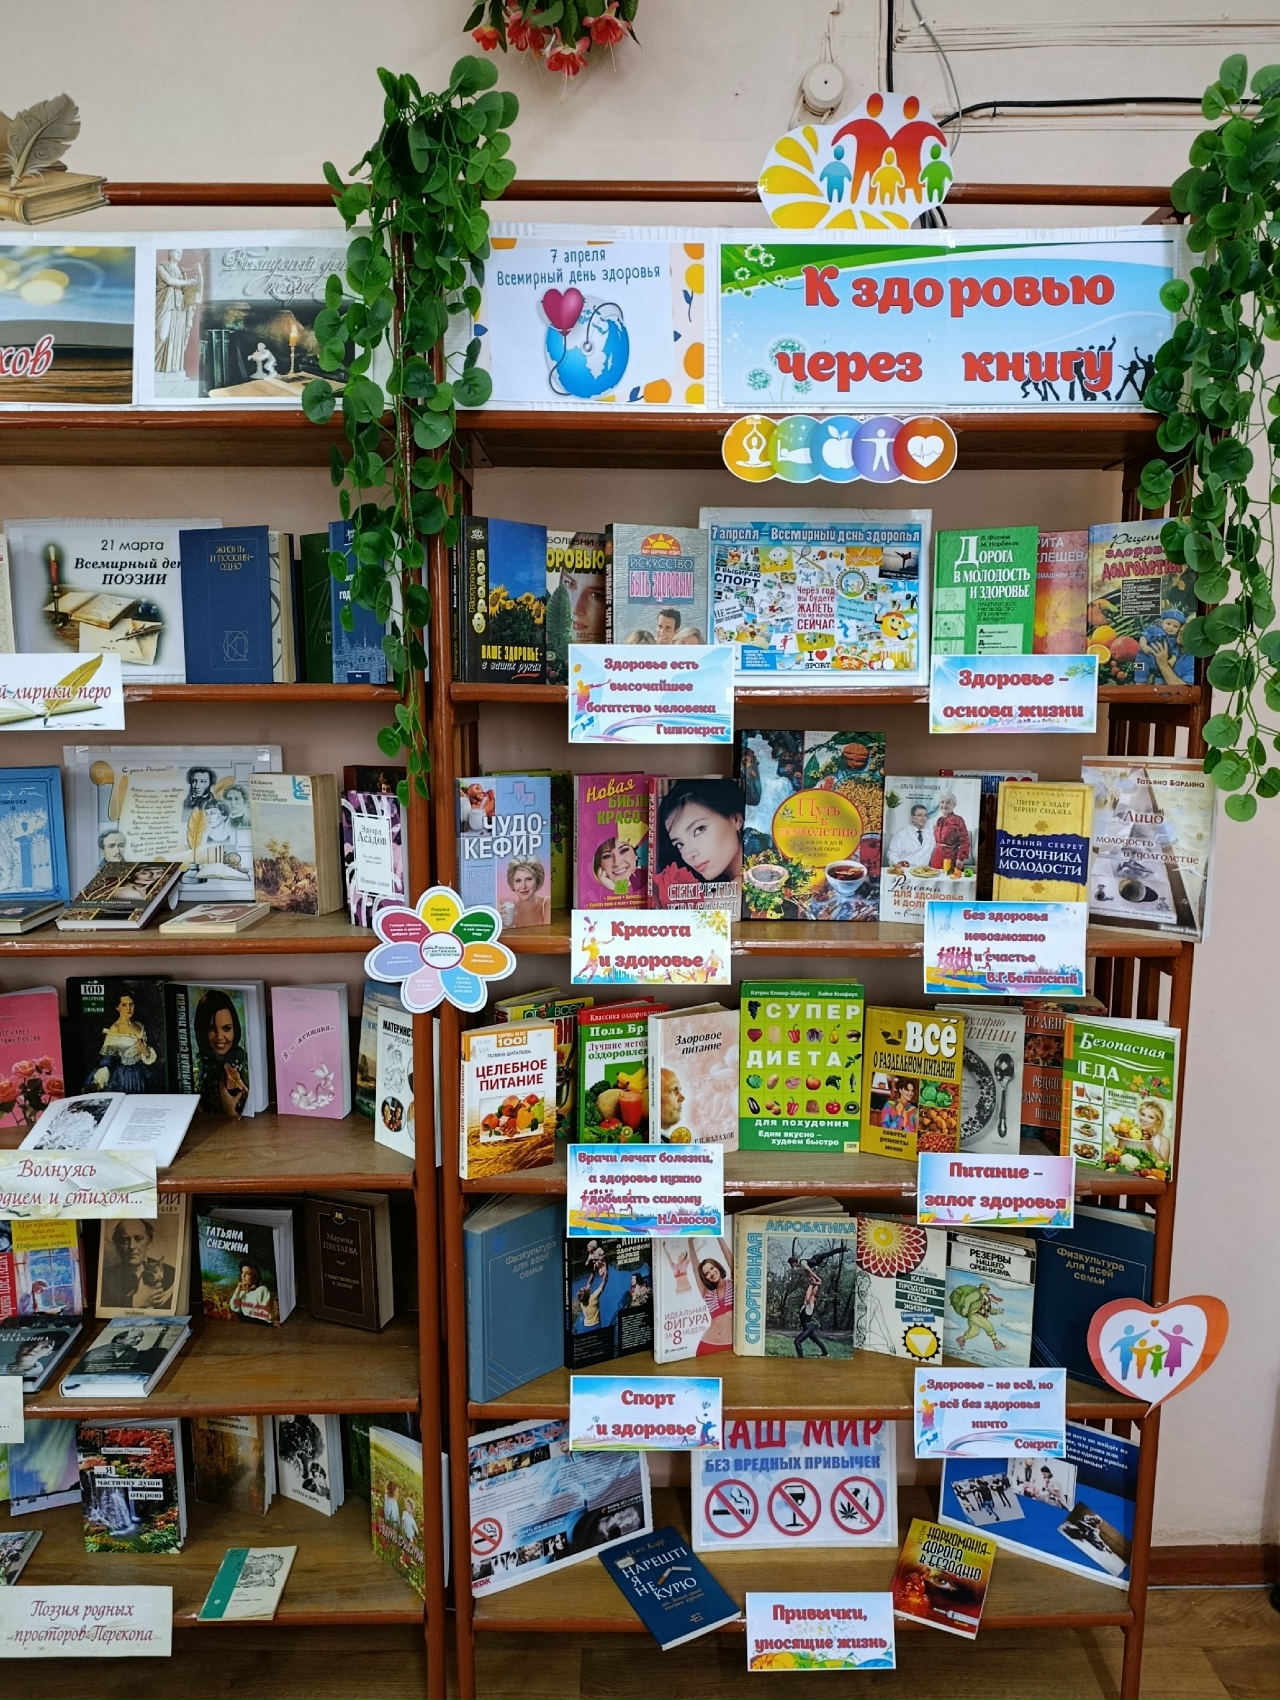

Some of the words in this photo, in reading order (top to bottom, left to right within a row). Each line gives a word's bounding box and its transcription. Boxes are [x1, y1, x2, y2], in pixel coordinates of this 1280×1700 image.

[551, 249, 557, 263] 7
[564, 250, 605, 267] апреля
[497, 269, 563, 289] Всемирный
[569, 270, 596, 284] день
[603, 266, 660, 285] здоровья
[803, 266, 839, 308] К
[853, 266, 1115, 318] здоровью
[774, 351, 922, 393] через
[963, 350, 1114, 393] книгу
[712, 527, 718, 538] 7
[720, 529, 758, 541] апреля
[771, 527, 835, 541] Всемирный
[837, 531, 864, 542] день
[867, 532, 919, 542] здоровья
[101, 540, 114, 550] 21
[119, 540, 163, 552] марта
[216, 546, 245, 554] ЖИЗНЬ
[74, 558, 157, 571] Всемирный
[220, 563, 242, 571] ОДНО
[630, 558, 693, 570] ИСКУССТВО
[102, 574, 167, 585] ПОЭЗИИ
[715, 573, 760, 588] СПОРТ
[963, 568, 1030, 584] МОЛОДОСТЬ
[630, 572, 650, 598] БЫТЬ
[652, 571, 693, 598] ЗДОРОВЫМ
[797, 587, 819, 596] Через
[979, 585, 1030, 599] ЗДОРОВЬЕ
[482, 645, 502, 659] ВАШЕ
[604, 659, 668, 672] Здоровье
[671, 660, 699, 670] есть
[610, 680, 693, 691] высочайшее
[959, 670, 1054, 689] Здоровье
[12, 685, 71, 701] лирики
[76, 686, 111, 703] перо
[586, 702, 651, 713] богатство
[654, 703, 715, 713] человека
[943, 705, 1013, 717] основа
[1018, 705, 1083, 717] жизни
[656, 723, 726, 737] Гиппократ
[1136, 778, 1167, 786] Татьяна
[586, 779, 635, 803] Новая
[797, 799, 841, 818] Путь
[483, 814, 547, 837] ЧУДО-
[1124, 812, 1163, 825] Лицо
[361, 825, 382, 834] Эдуард
[358, 834, 387, 845] Асадов
[1000, 838, 1042, 846] ДРЕВНИЙ
[1048, 842, 1083, 850] СЕКРЕТ
[464, 835, 542, 859] КЕФИР
[999, 848, 1081, 863] ИСТОЧНИКА
[1136, 851, 1199, 864] долголетие
[999, 861, 1082, 876] МОЛОДОСТИ
[668, 882, 737, 900] СЕКРЕТЫ
[894, 891, 912, 899] ДЛЯ
[963, 910, 985, 920] Без
[988, 911, 1048, 923] здоровья
[611, 922, 691, 940] Красота
[964, 933, 1046, 942] невозможно
[599, 956, 610, 967] и
[615, 956, 704, 970] здоровье
[986, 953, 1035, 963] счастье
[986, 972, 1078, 984] В.Г.Белинский
[81, 985, 104, 994] 100
[590, 1013, 620, 1021] Классика
[766, 1004, 860, 1019] СУПЕР
[590, 1026, 624, 1036] Поль
[675, 1031, 722, 1045] Здоровое
[498, 1036, 526, 1047] 100!
[588, 1042, 622, 1052] Лучшие
[1079, 1033, 1166, 1059] Безопасная
[682, 1042, 721, 1056] питание
[747, 1051, 841, 1068] ДИЕТА
[879, 1052, 922, 1074] РАЗДЕЛЬНОМ
[923, 1059, 955, 1079] ПИТАНИИ
[476, 1059, 547, 1078] ЦЕЛЕБНОЕ
[479, 1074, 544, 1091] ПИТАНИЕ
[755, 1119, 778, 1127] для
[883, 1130, 906, 1138] советы
[771, 1138, 803, 1146] худеем
[880, 1137, 909, 1146] рецепты
[578, 1153, 617, 1164] Врачи
[620, 1154, 656, 1163] лечат
[659, 1152, 713, 1165] болезни,
[18, 1159, 96, 1181] Волнуясь
[950, 1162, 1029, 1179] Питание
[600, 1174, 657, 1185] здоровье
[660, 1174, 702, 1185] нужно
[49, 1194, 60, 1204] и
[588, 1194, 649, 1206] добывать
[653, 1195, 702, 1206] самому
[925, 1195, 975, 1207] залог
[980, 1196, 1066, 1212] здоровья
[658, 1214, 716, 1225] Н.Амосов
[766, 1220, 857, 1233] АКРОБАТИКА
[206, 1226, 243, 1240] ТАТЬЯНА
[326, 1233, 354, 1245] Марина
[207, 1239, 248, 1253] СНЕЖИНА
[323, 1242, 357, 1255] ЦВЕТАЕВА
[506, 1241, 556, 1265] Физкультура
[970, 1249, 1012, 1264] РЕЗЕРВЫ
[976, 1258, 1005, 1268] НАШЕГО
[1057, 1248, 1124, 1272] Физкультура
[513, 1262, 528, 1272] для
[1066, 1260, 1085, 1270] для
[1089, 1265, 1114, 1278] всей
[911, 1275, 925, 1283] КАК
[1074, 1272, 1105, 1286] семьи
[745, 1233, 763, 1344] СПОРТИВНАЯ
[898, 1283, 938, 1295] ПРОДЛИТЬ
[907, 1294, 927, 1303] ГОДЫ
[664, 1306, 706, 1320] ИДЕАЛЬНАЯ
[904, 1303, 932, 1313] ЖИЗНИ
[664, 1313, 709, 1330] ФИГУРА
[683, 1326, 706, 1335] НЕДЕЛЬ
[927, 1379, 984, 1391] Здоровье
[996, 1381, 1010, 1389] не
[621, 1390, 676, 1408] Спорт
[939, 1400, 959, 1408] всё
[962, 1400, 981, 1408] без
[983, 1401, 1040, 1410] здоровья
[612, 1423, 696, 1440] здоровье
[972, 1421, 1008, 1429] ничто
[803, 1420, 884, 1447] МИР
[1014, 1439, 1058, 1451] Сократ
[705, 1459, 730, 1472] БЕЗ
[734, 1457, 801, 1471] ВРЕДНЫХ
[805, 1456, 880, 1470] ПРИВЫЧЕК
[97, 1479, 135, 1487] частичку
[138, 1480, 161, 1488] души
[130, 1492, 162, 1500] открою
[922, 1541, 963, 1561] ДОРОГА
[622, 1547, 688, 1578] НАРЕШТІ
[928, 1555, 982, 1582] БЕЗОДНЮ
[655, 1577, 697, 1601] КУРЮ
[31, 1600, 80, 1620] Поэзия
[83, 1603, 134, 1620] родных
[773, 1605, 867, 1624] Привычки,
[14, 1626, 87, 1645] просторов
[90, 1626, 153, 1645] Перекопа
[755, 1638, 833, 1653] уносящие
[837, 1638, 887, 1648] жизнь
